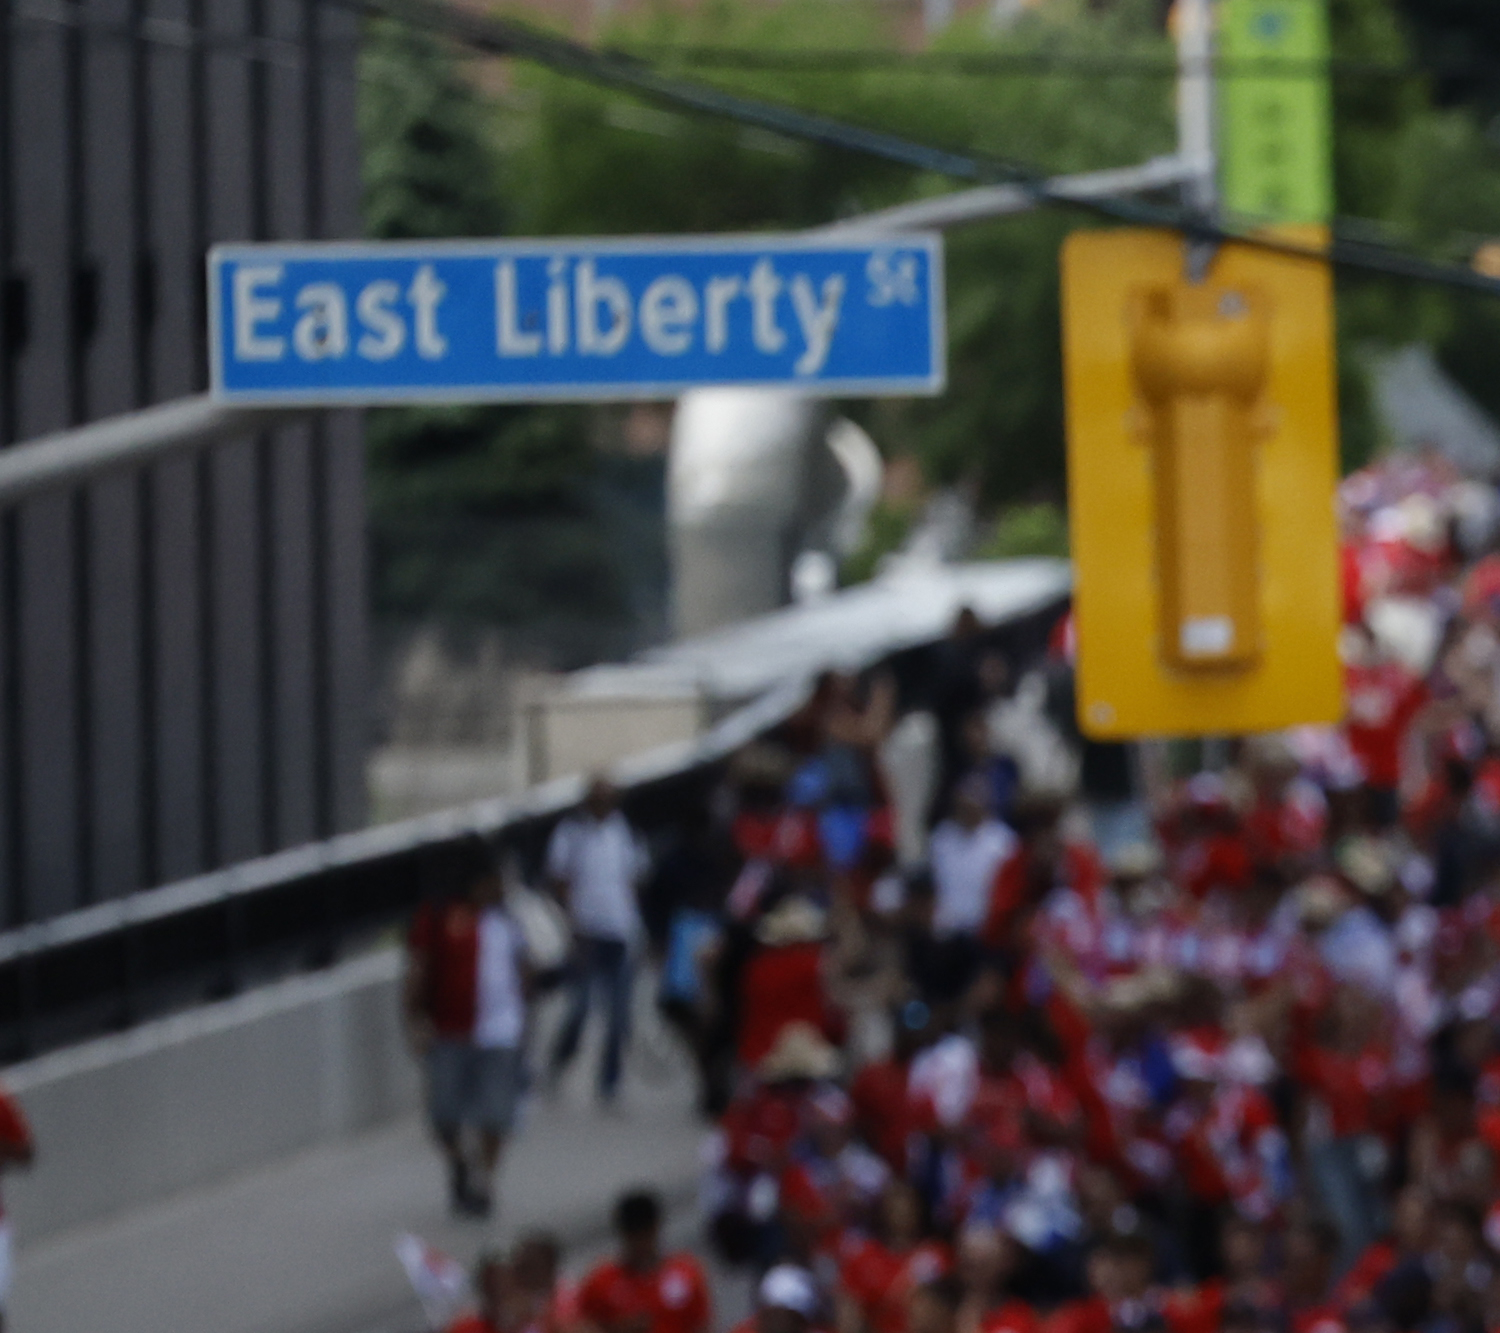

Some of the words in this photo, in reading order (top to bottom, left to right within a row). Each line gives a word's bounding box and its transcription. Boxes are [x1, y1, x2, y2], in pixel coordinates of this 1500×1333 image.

[232, 264, 447, 362] East
[495, 257, 847, 375] Liberty
[866, 250, 917, 308] St
